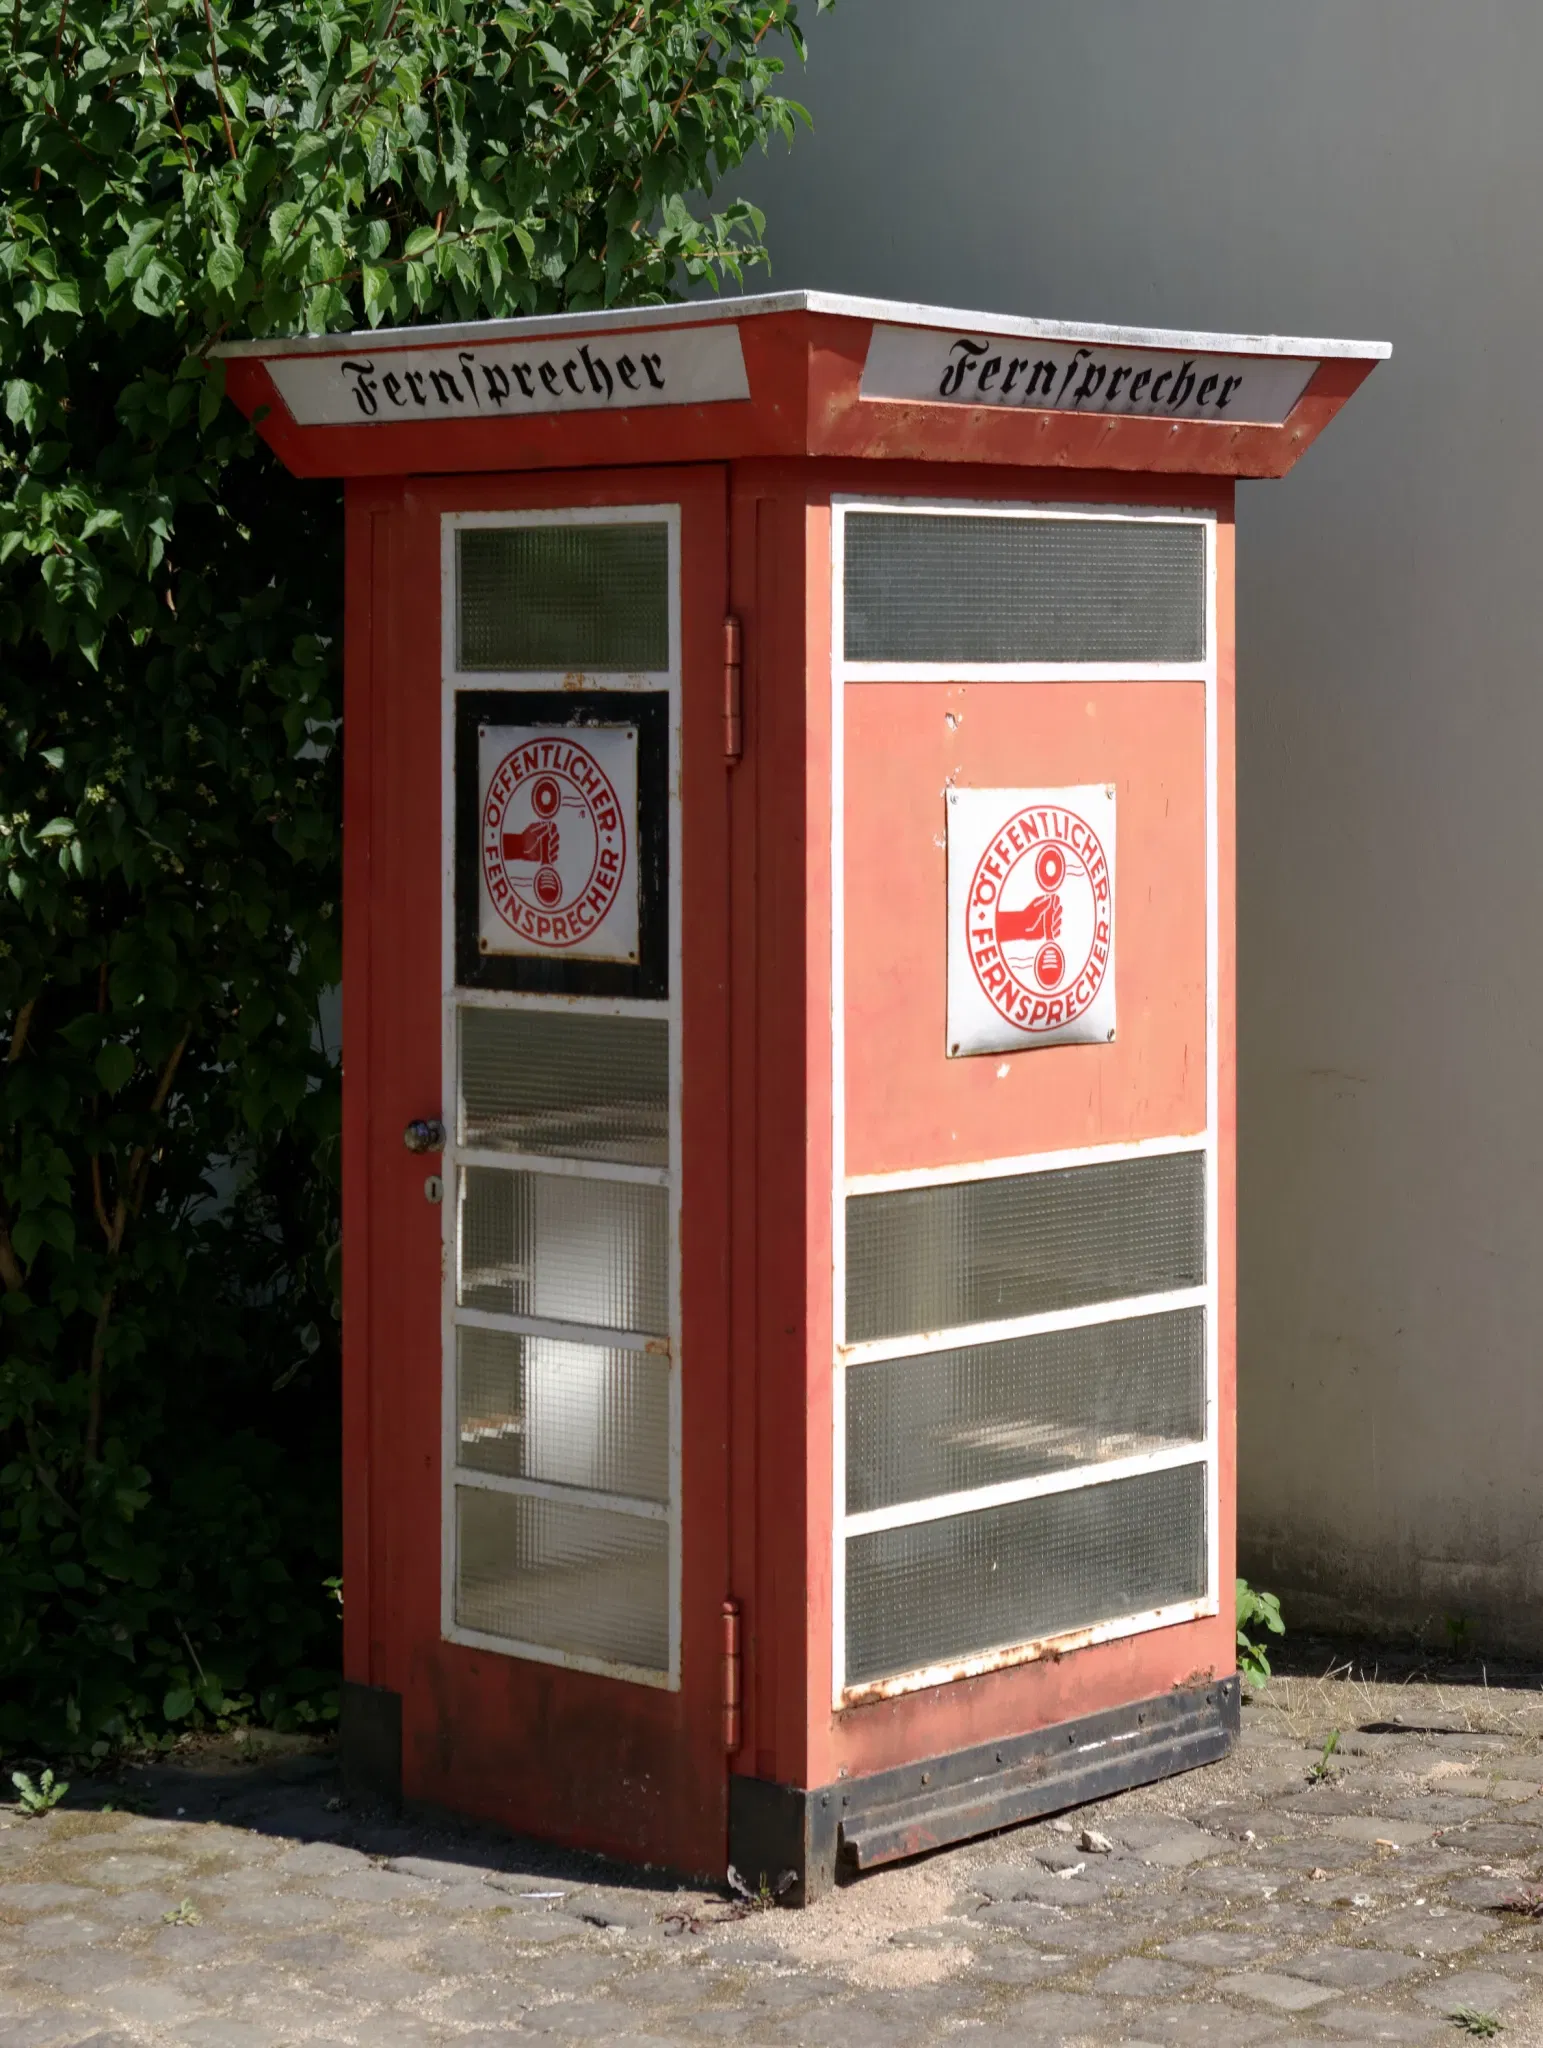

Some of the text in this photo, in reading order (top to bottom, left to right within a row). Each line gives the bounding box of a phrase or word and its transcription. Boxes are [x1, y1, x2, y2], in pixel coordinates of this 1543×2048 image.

[486, 745, 618, 832] ÖFFENTLICHER
[486, 845, 620, 940] FERNSPRECHER
[973, 812, 1108, 907] ÖFFENTLICHER
[972, 920, 1109, 1026] FERNSPRECHER
